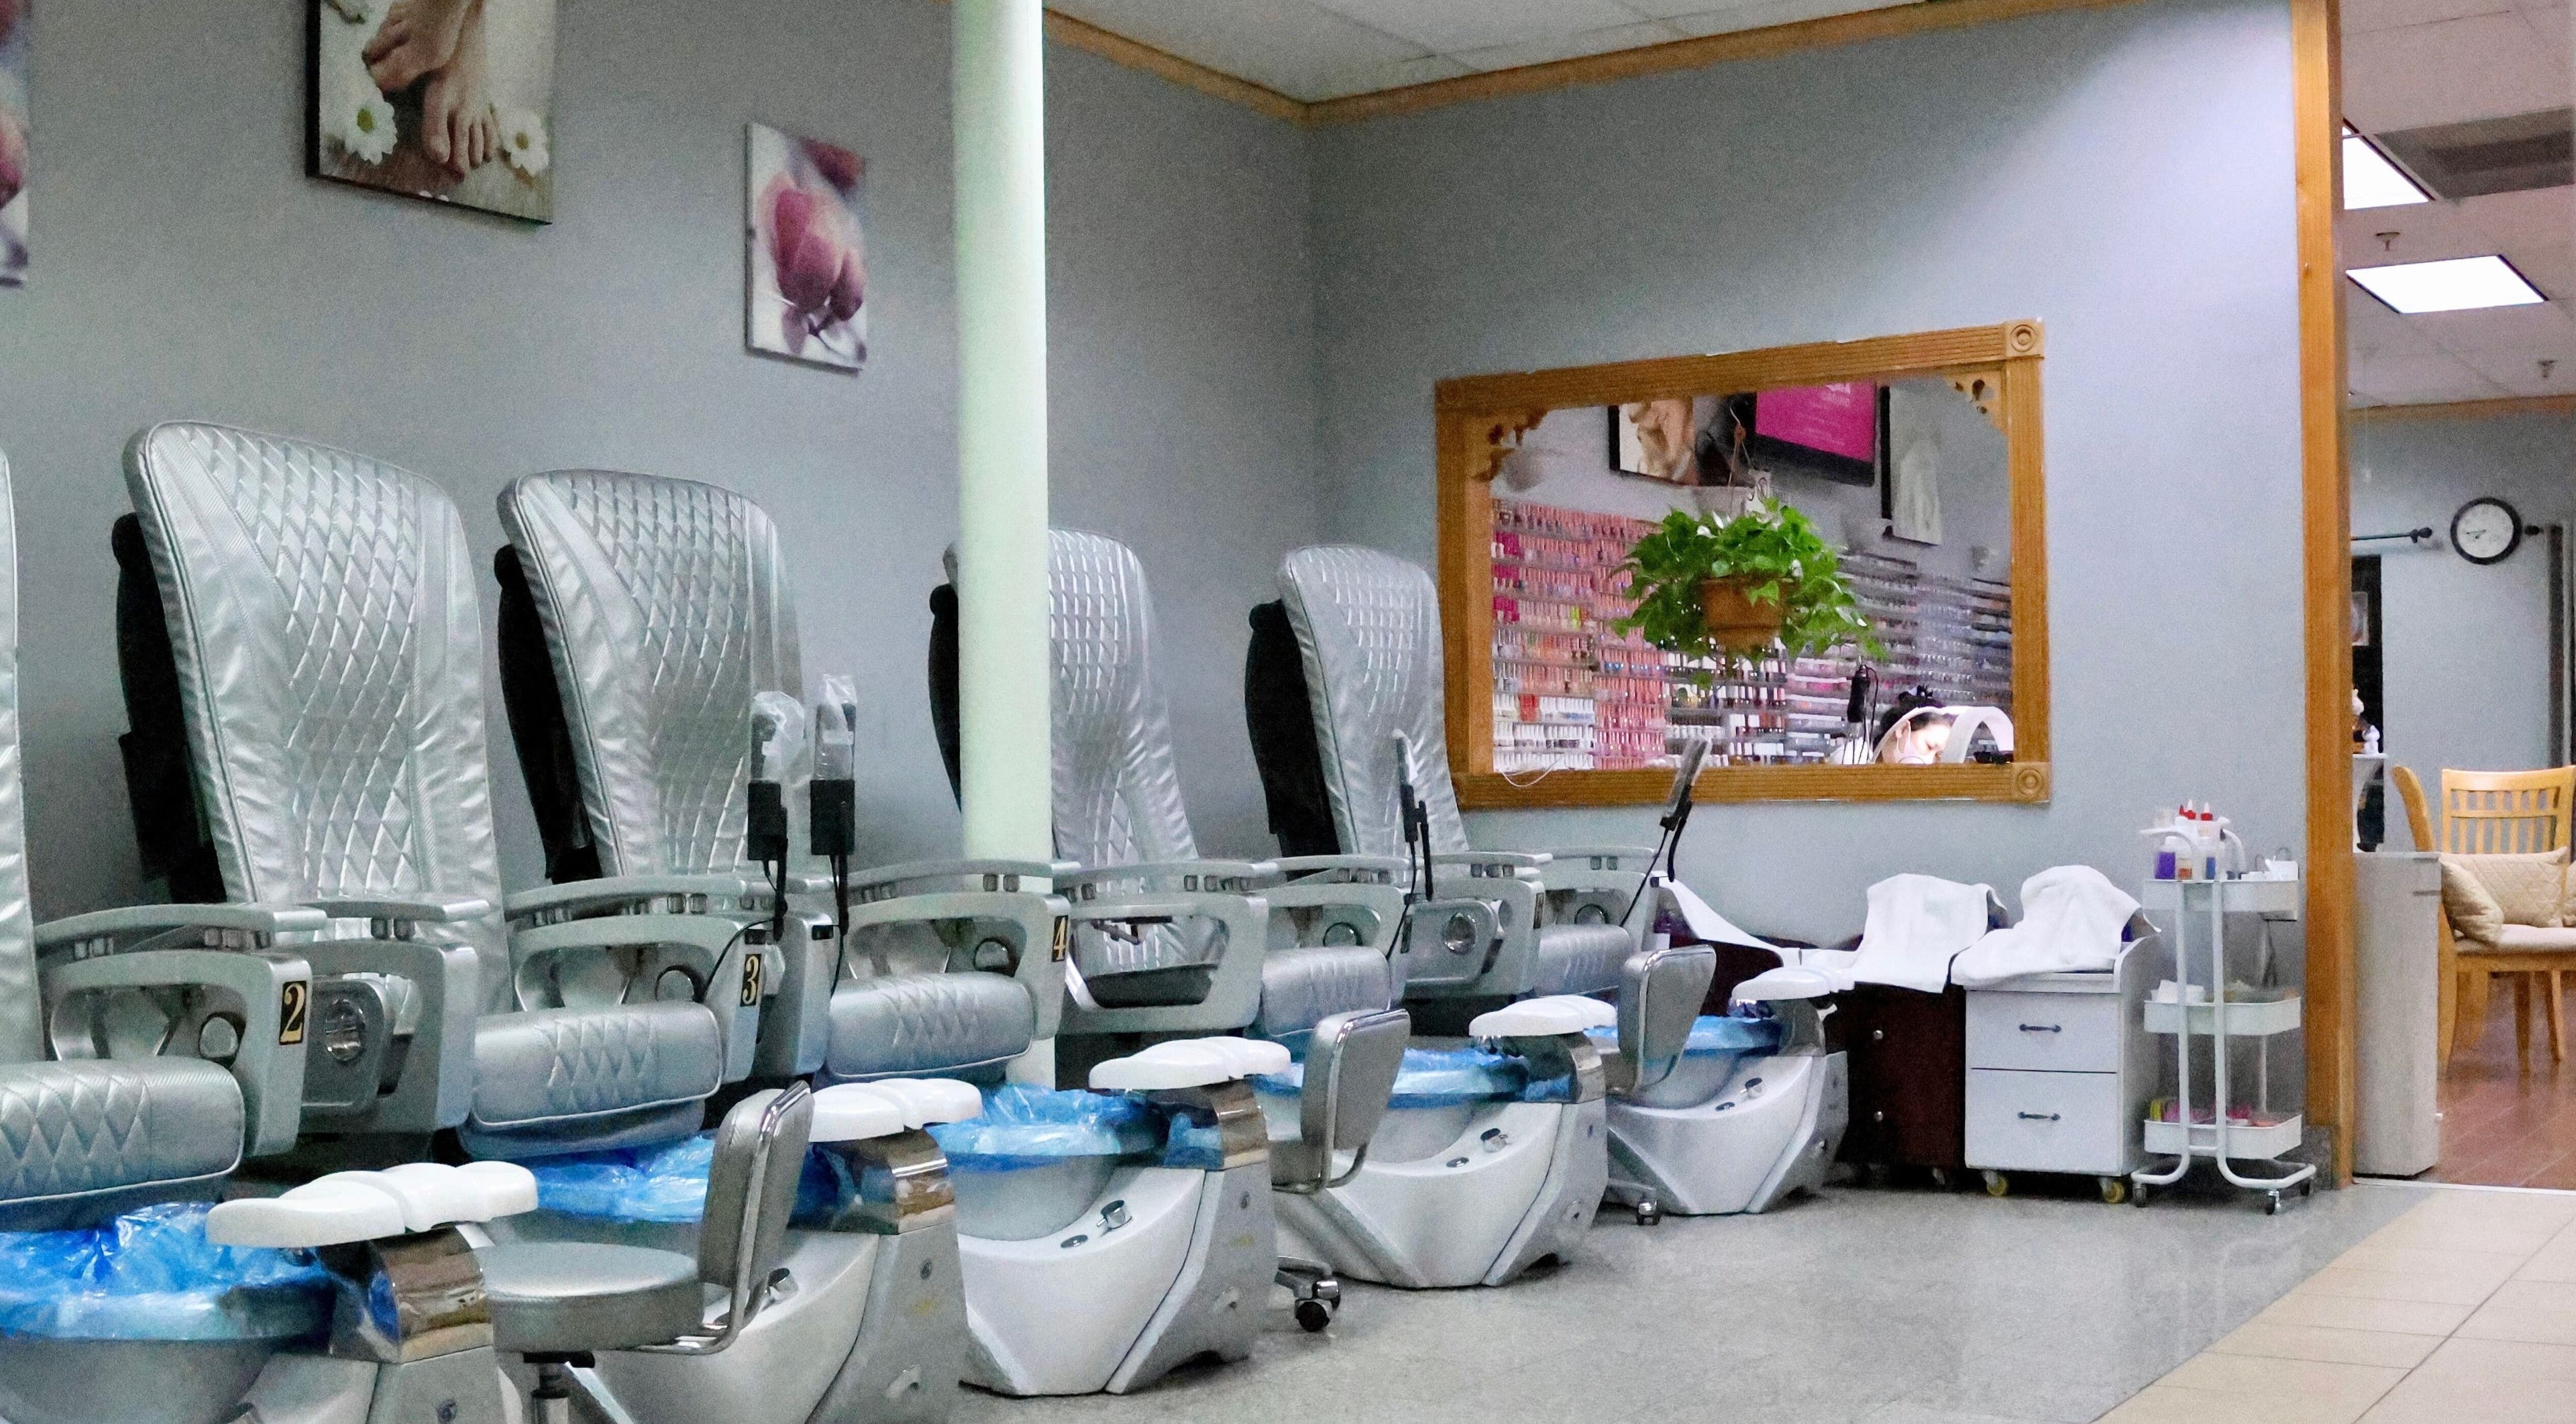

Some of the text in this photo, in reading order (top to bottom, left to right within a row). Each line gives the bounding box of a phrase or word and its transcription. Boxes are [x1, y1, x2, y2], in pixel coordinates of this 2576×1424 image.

[1053, 917, 1065, 960] 4
[743, 955, 759, 1005] 3
[280, 983, 305, 1042] 2
